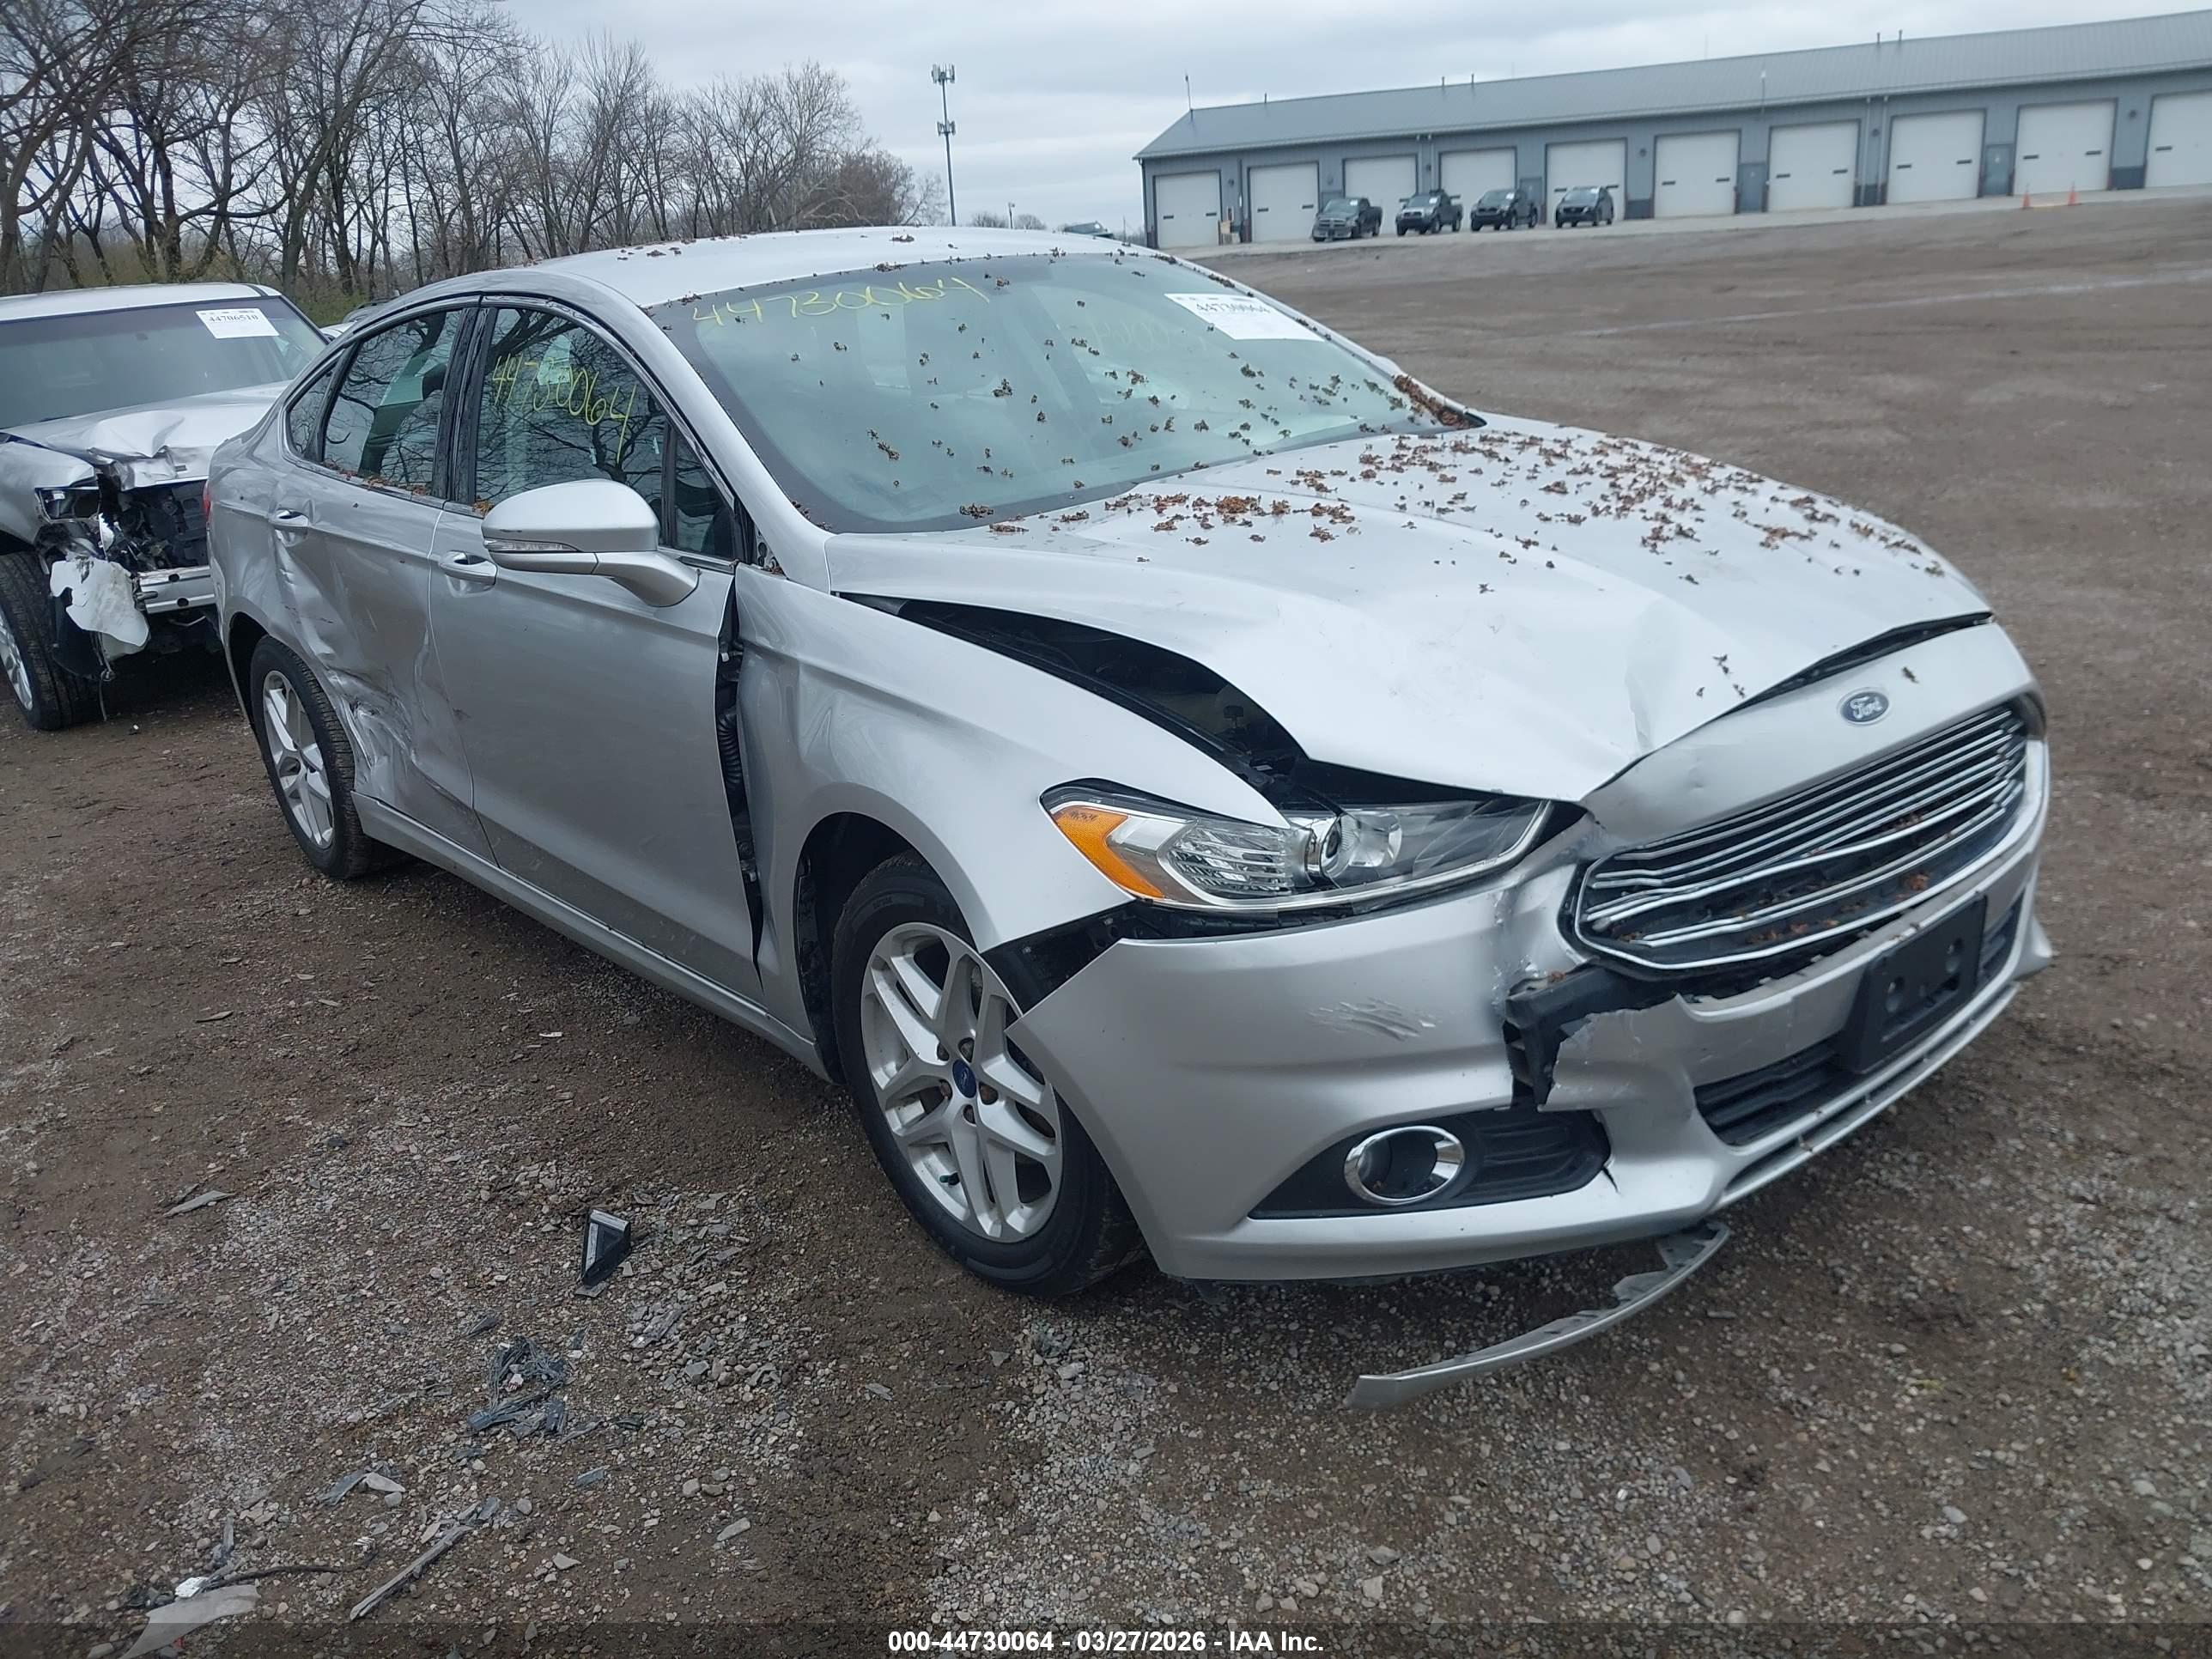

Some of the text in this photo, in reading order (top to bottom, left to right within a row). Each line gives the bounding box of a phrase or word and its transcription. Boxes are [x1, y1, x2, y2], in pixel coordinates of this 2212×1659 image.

[693, 276, 990, 326] 44730064
[492, 353, 637, 465] 44730064
[1850, 695, 1884, 720] Ford
